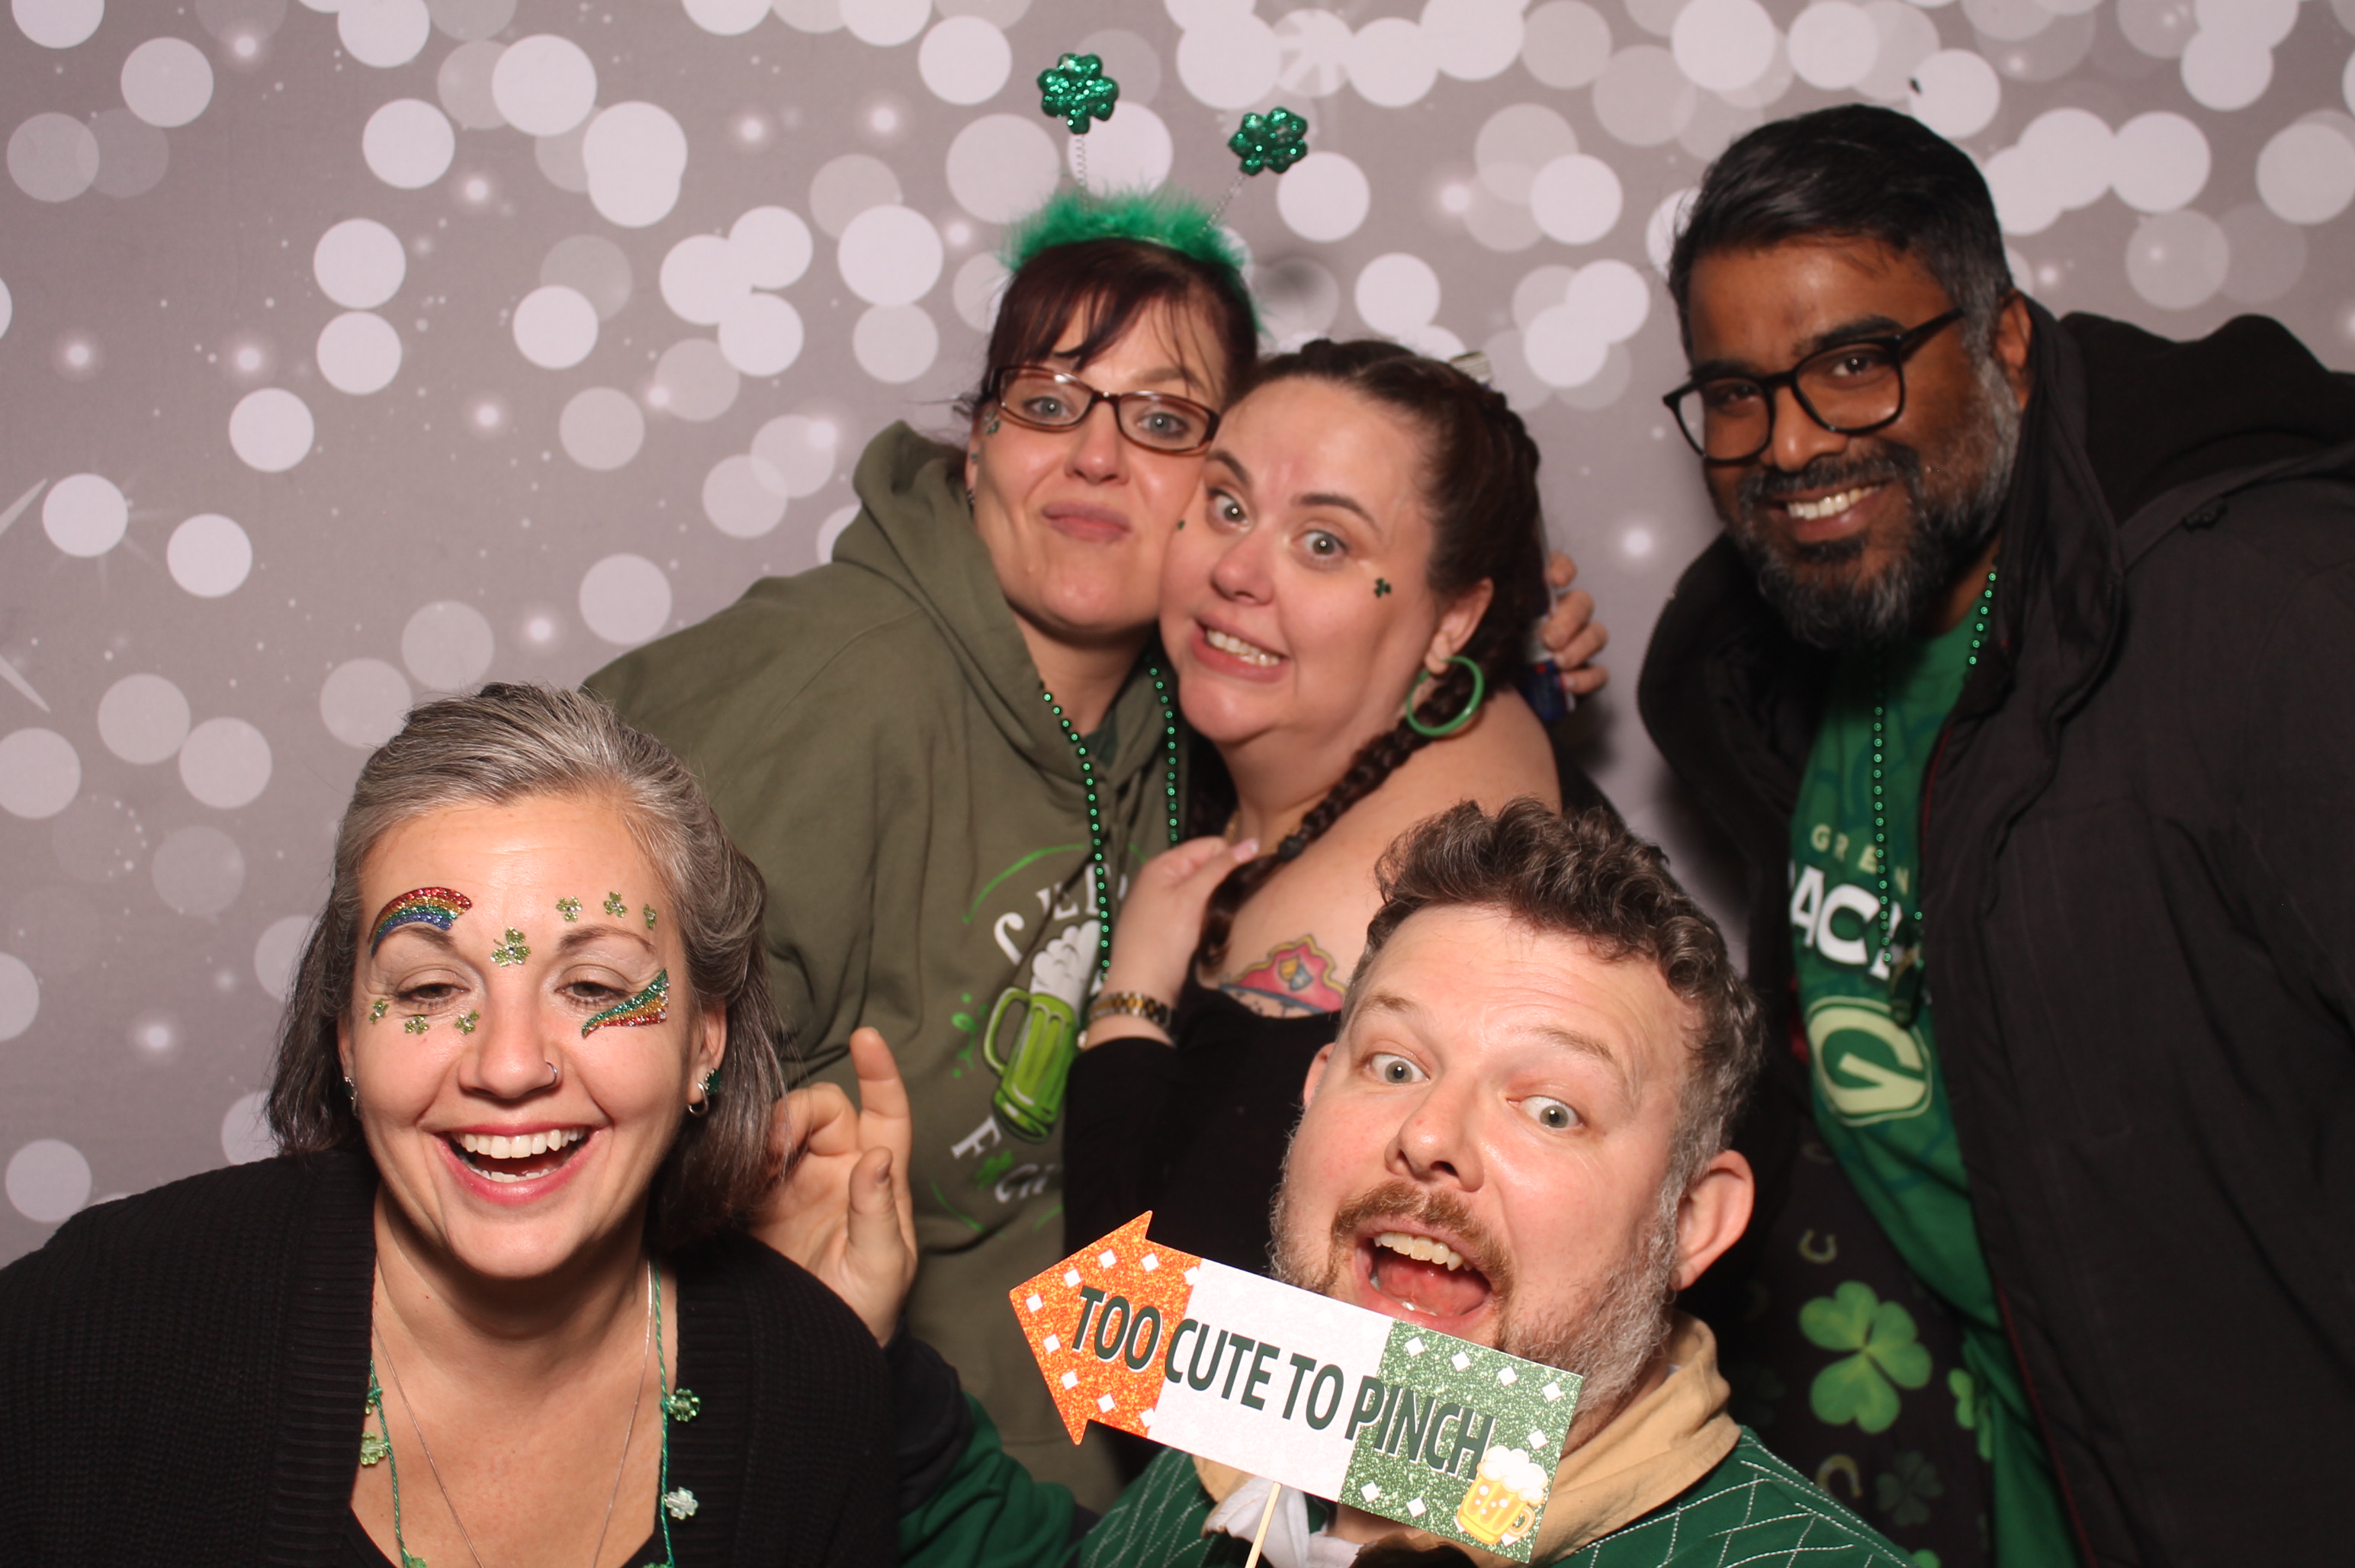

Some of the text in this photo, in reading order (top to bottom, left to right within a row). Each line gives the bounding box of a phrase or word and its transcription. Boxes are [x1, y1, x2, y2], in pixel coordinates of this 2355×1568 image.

[1071, 1286, 1496, 1481] TOO CUTE TO PINCH
